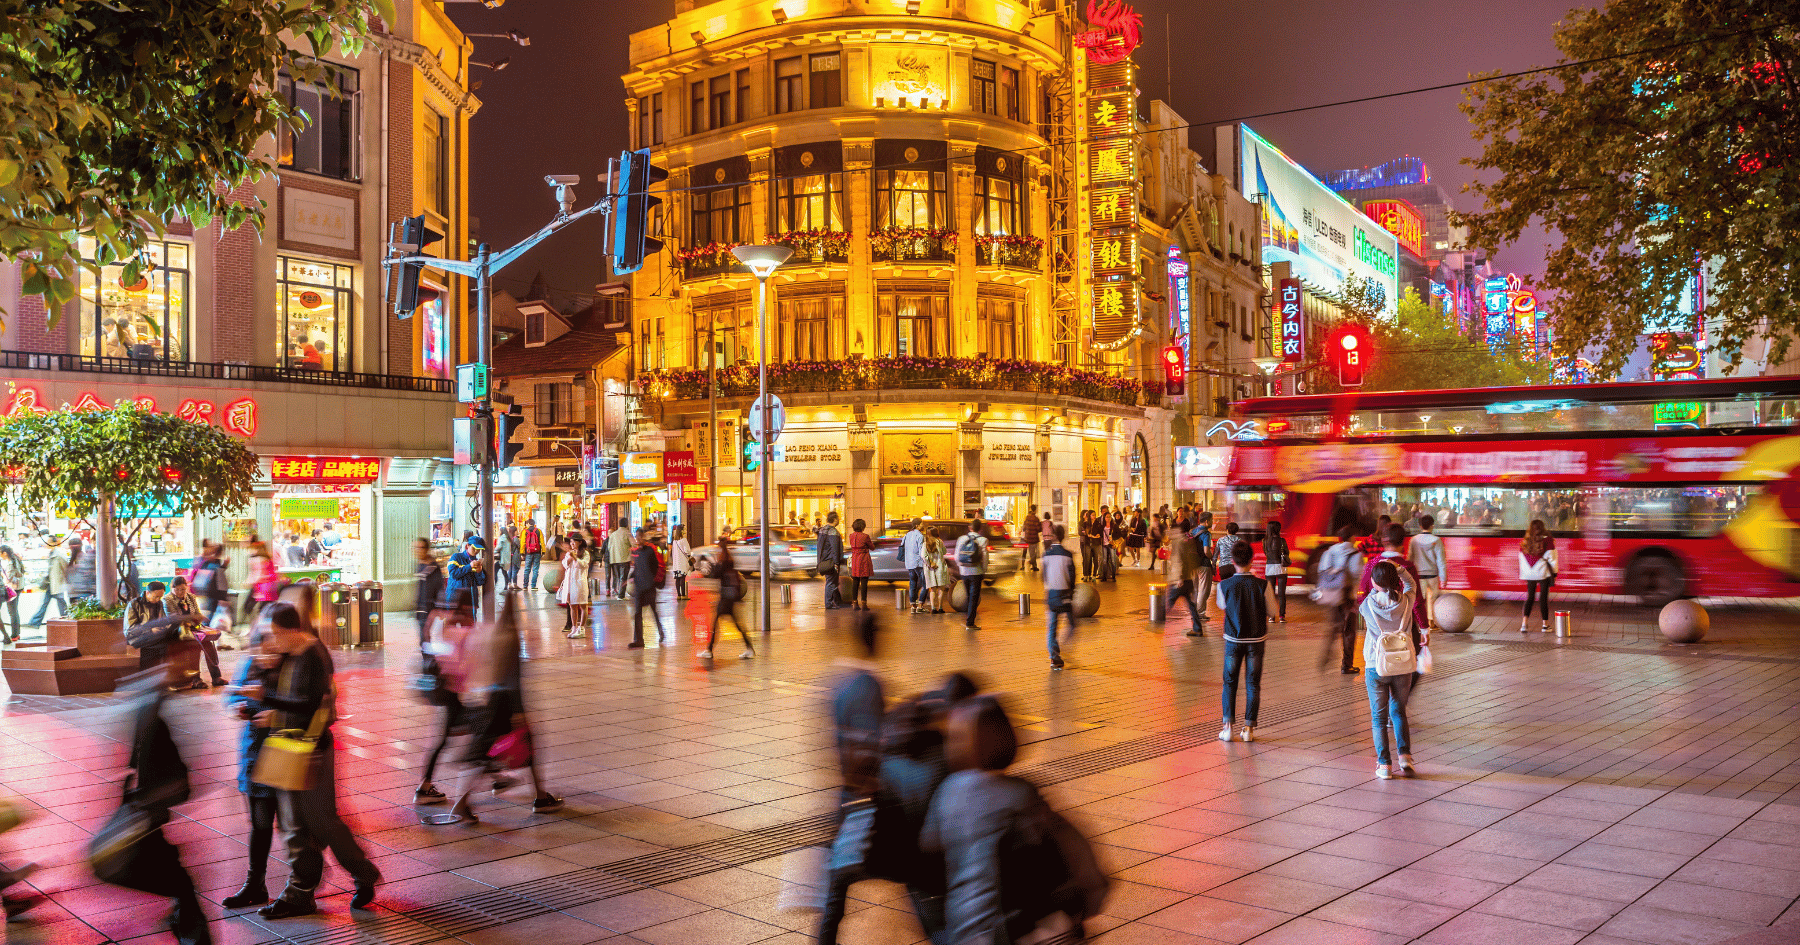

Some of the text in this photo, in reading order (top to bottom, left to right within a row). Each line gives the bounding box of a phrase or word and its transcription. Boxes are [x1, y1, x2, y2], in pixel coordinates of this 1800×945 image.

[1353, 224, 1395, 280] Hisense
[1281, 285, 1300, 355] 古今内衣
[785, 445, 797, 453] LAO
[818, 444, 838, 452] XIANG
[1003, 443, 1016, 451] FENG
[785, 454, 842, 463] EWELLERS STORE
[988, 453, 1032, 461] JEWELLERS STORE
[322, 461, 379, 478] 品牌特色
